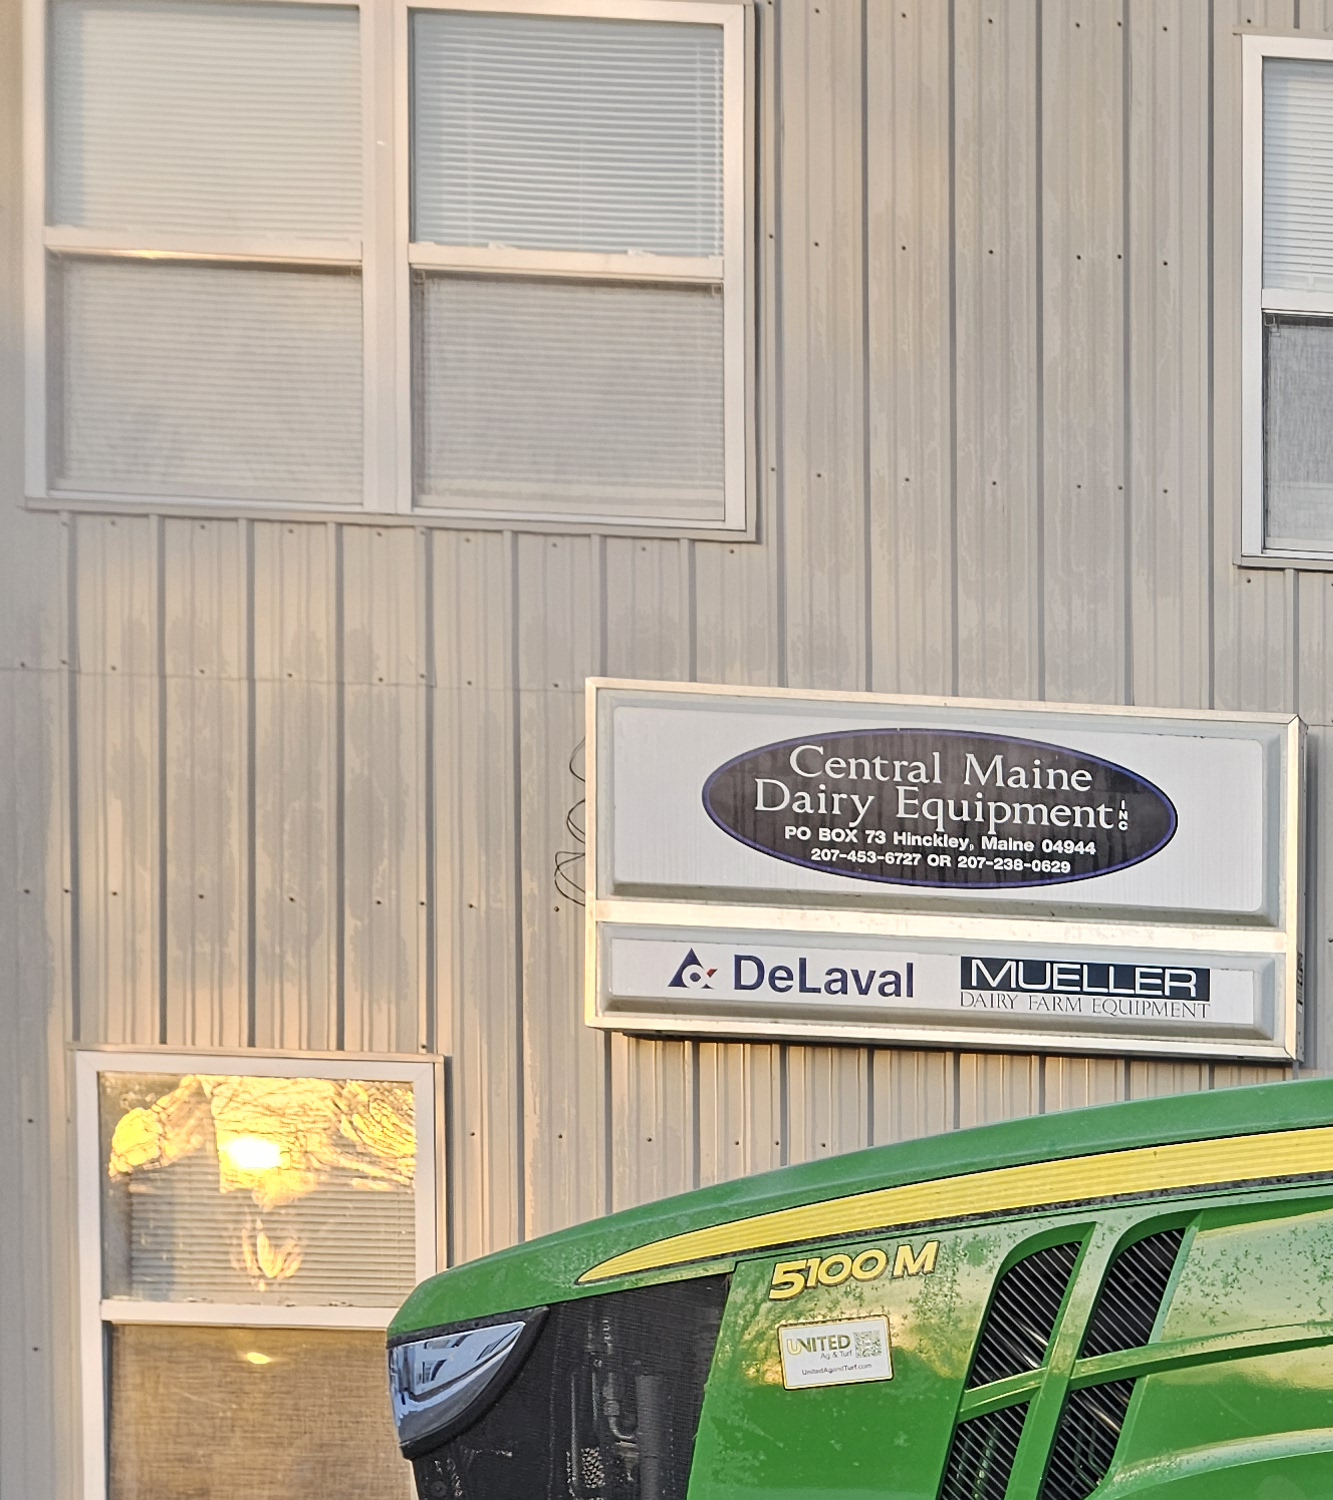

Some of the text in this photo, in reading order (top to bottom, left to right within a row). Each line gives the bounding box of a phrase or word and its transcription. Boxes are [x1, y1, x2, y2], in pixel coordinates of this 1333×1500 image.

[789, 744, 1093, 792] Central Maine
[754, 777, 1114, 835] Dairy Equipment
[1117, 799, 1129, 832] INC
[784, 825, 811, 841] PO
[818, 827, 859, 843] BOX
[865, 829, 887, 845] 73
[981, 836, 1035, 853] Maine
[1042, 838, 1097, 856] 04944
[811, 848, 1071, 874] 207-453-6727 OR 207-238-0629
[733, 953, 914, 999] DeLaval
[970, 958, 1197, 997] MUELLER
[960, 990, 1212, 1020] DAIRY FARM EQUIPMENT
[786, 1333, 851, 1356] UNITED
